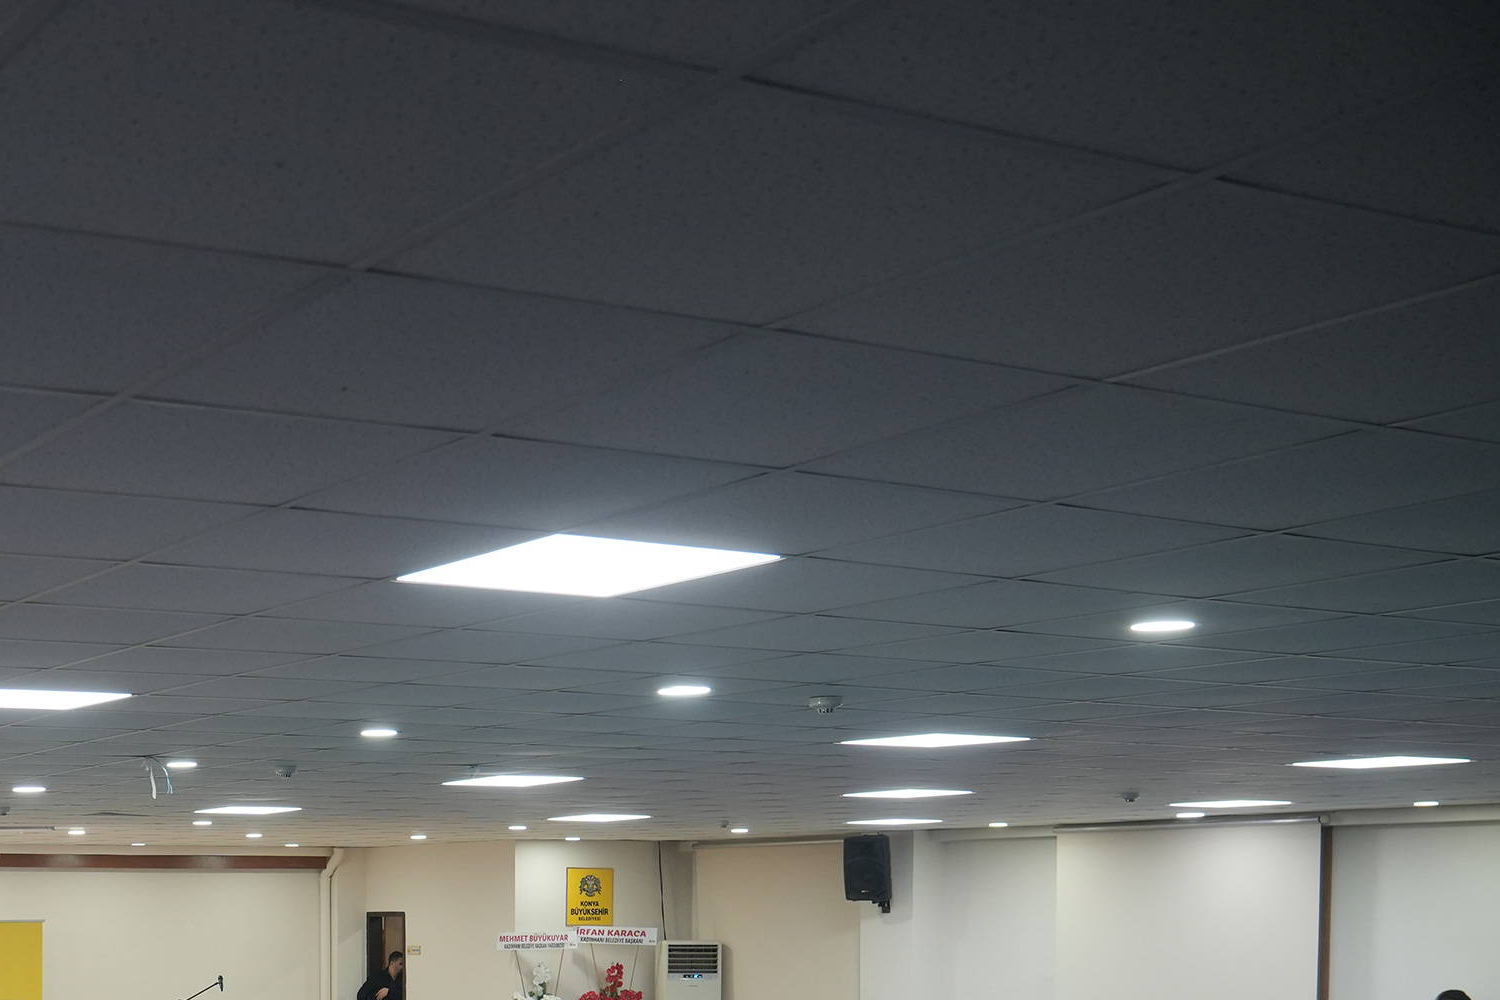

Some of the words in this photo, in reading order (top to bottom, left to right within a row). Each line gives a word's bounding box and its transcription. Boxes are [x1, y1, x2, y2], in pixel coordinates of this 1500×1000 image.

[570, 907, 609, 916] BÜYÜKŞEHİR
[499, 934, 528, 943] MEHMET
[529, 932, 569, 942] BÜYÜKUYAR
[576, 926, 605, 937] İRFAN
[607, 929, 647, 939] KARACA
